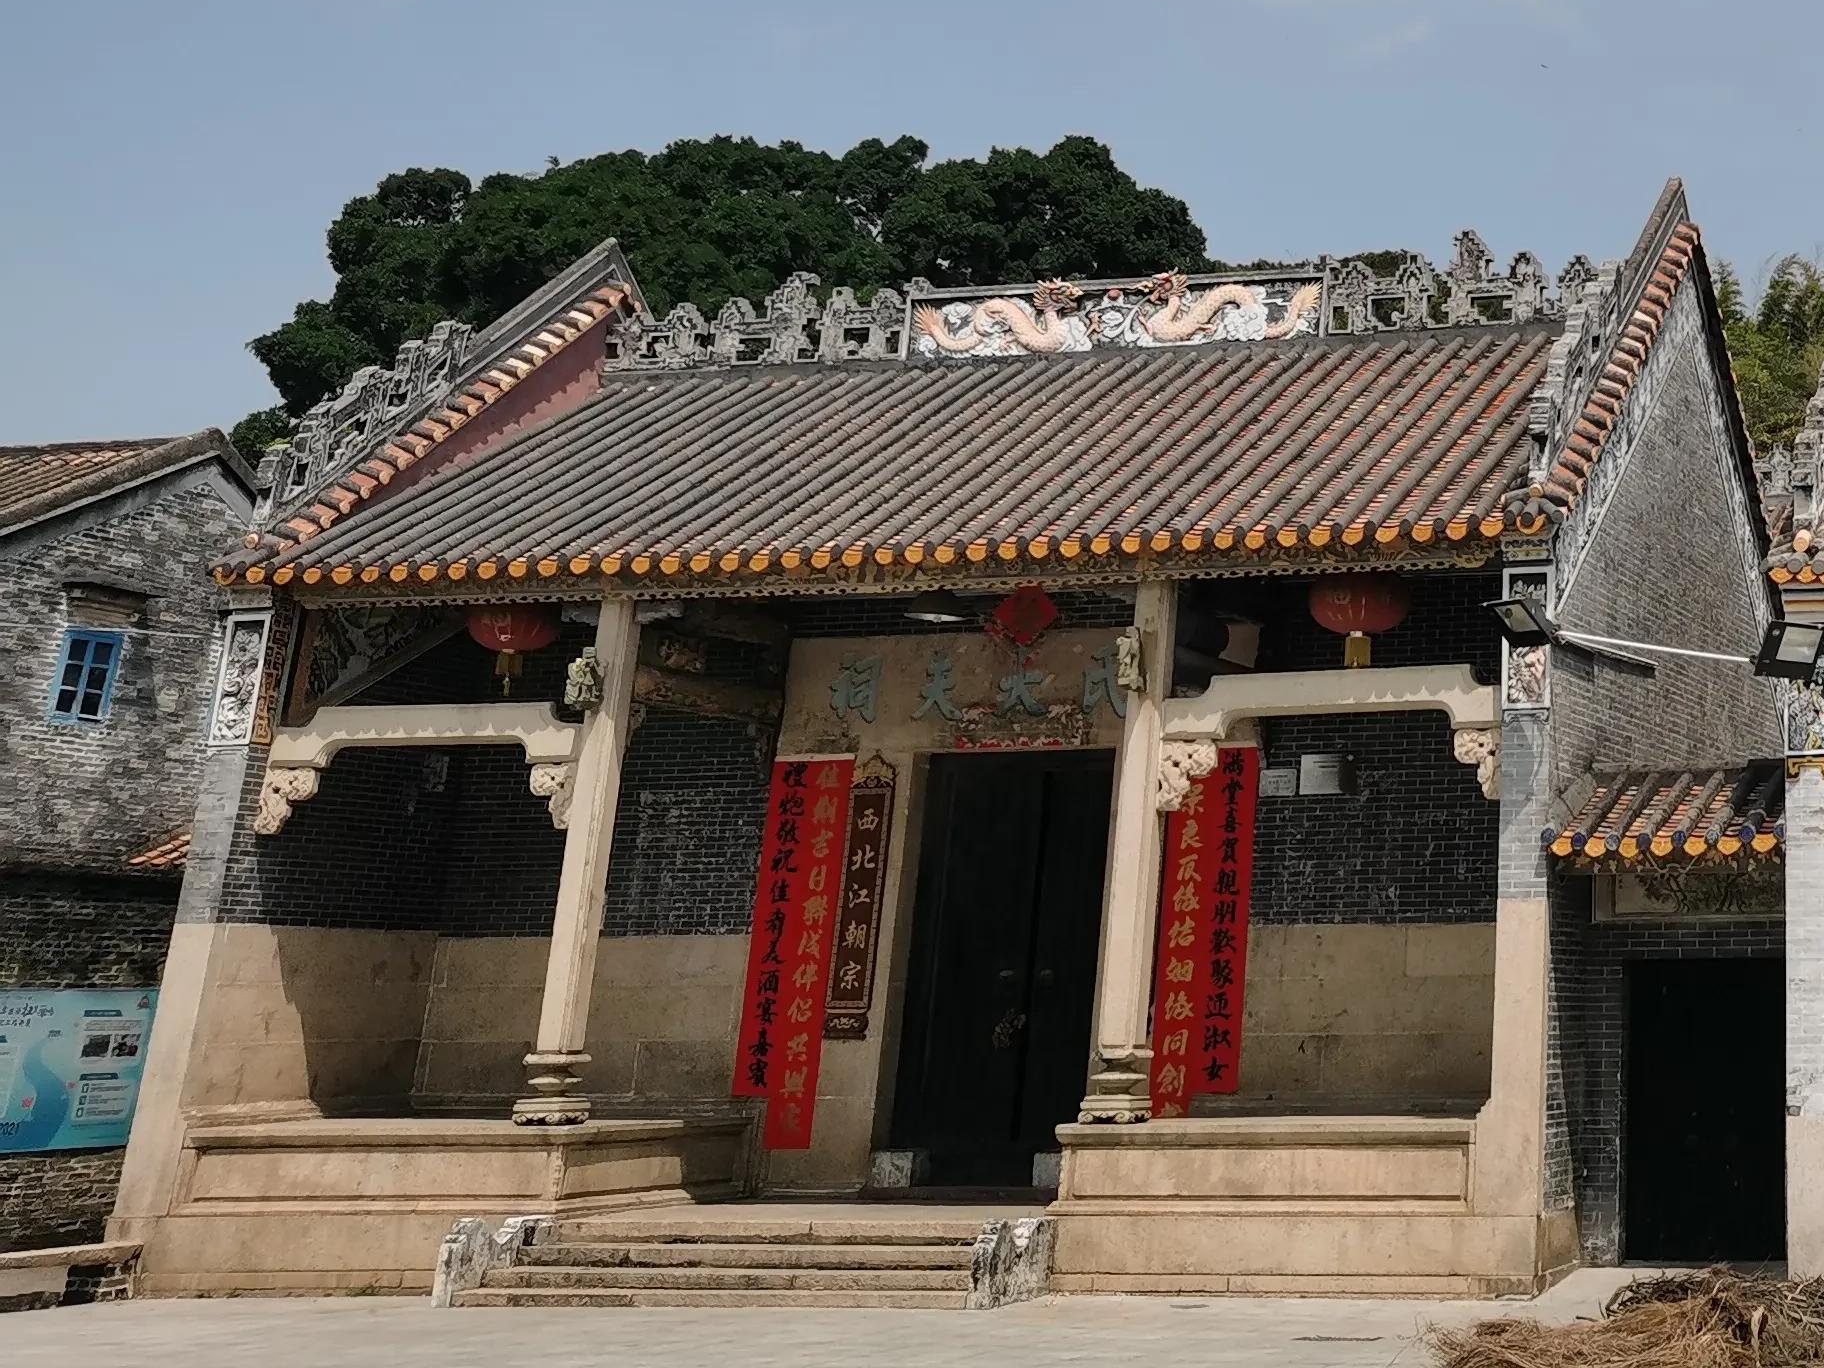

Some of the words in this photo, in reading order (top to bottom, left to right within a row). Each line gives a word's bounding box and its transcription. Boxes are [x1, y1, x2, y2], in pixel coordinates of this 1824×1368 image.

[839, 808, 880, 990] 西北江朝宗
